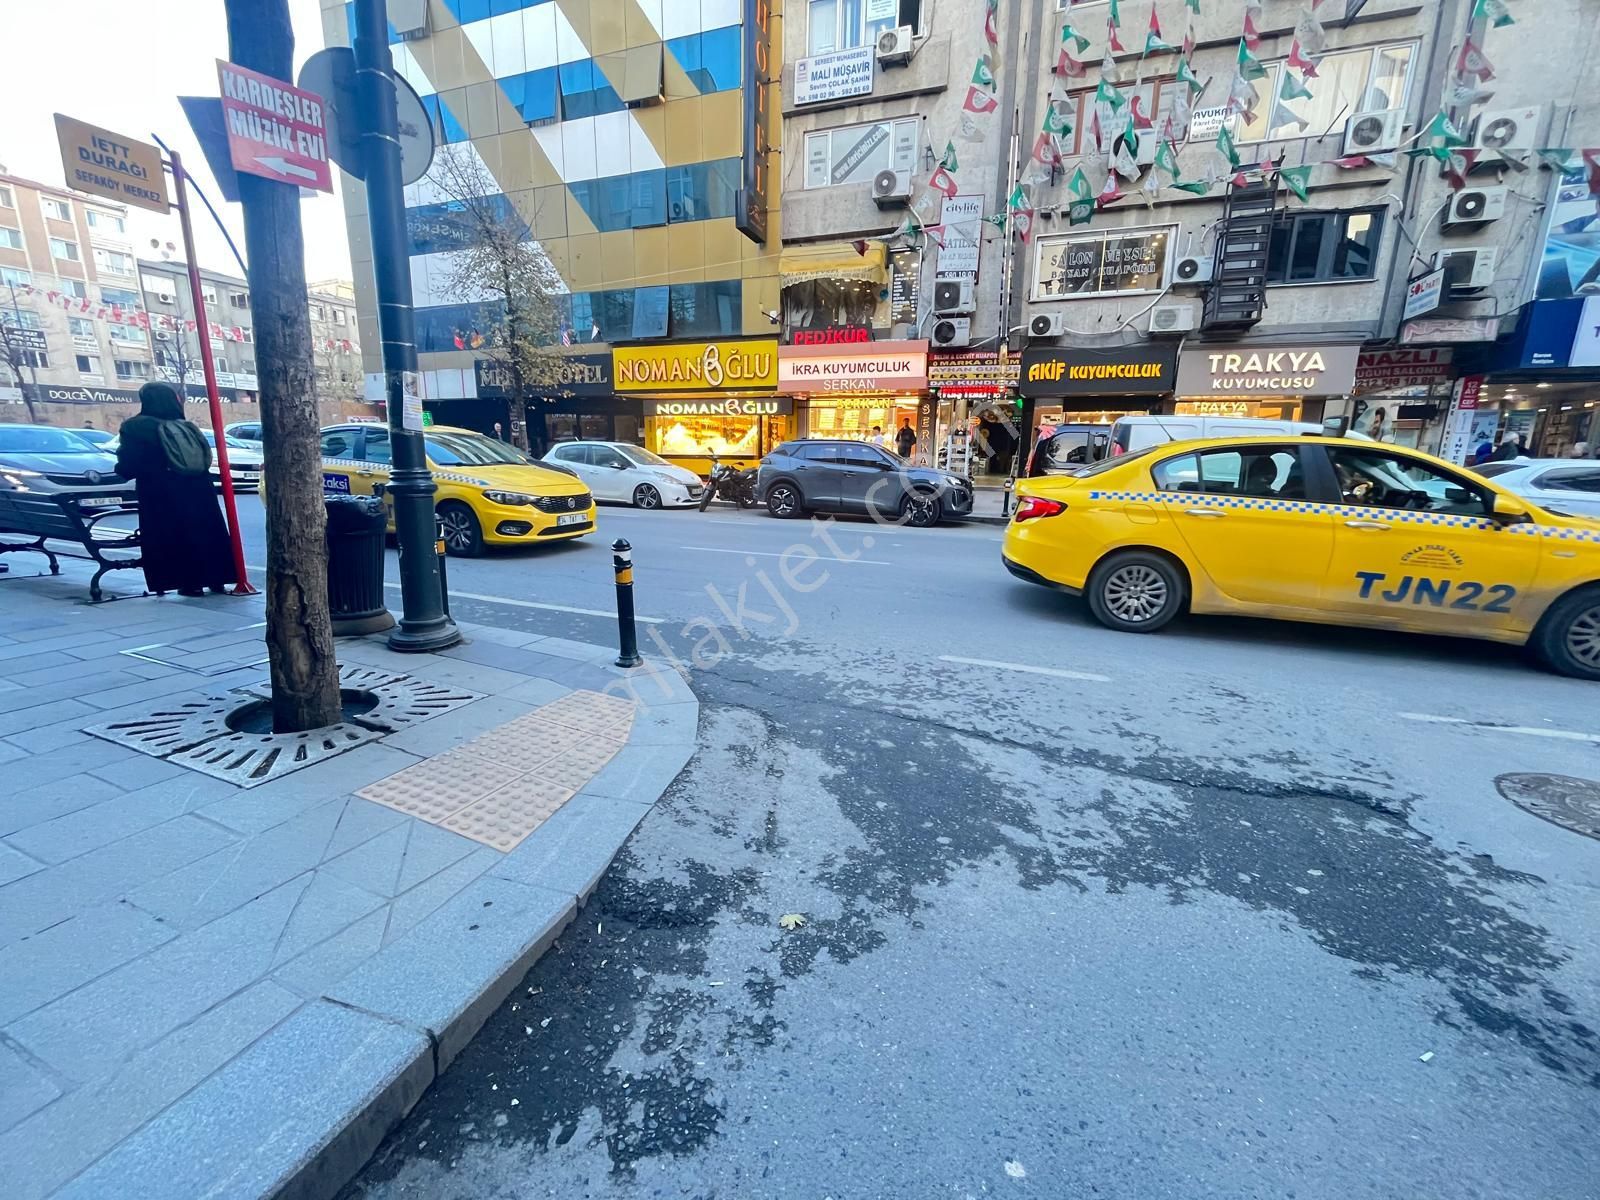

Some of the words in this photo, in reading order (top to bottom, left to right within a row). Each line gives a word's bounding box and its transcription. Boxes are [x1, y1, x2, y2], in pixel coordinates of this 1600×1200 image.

[810, 66, 831, 82] MALİ
[833, 60, 870, 78] MÜŞAVİR
[828, 78, 850, 89] ÇOLAK
[851, 74, 870, 86] ŞAHİN
[222, 69, 323, 129] KARDEŞLER
[1193, 107, 1233, 120] AVUKAT
[227, 108, 295, 153] MÜZİK
[296, 130, 326, 163] EVİ
[78, 146, 148, 179] DURAĞI
[75, 169, 120, 191] SEFAKÖY
[123, 183, 162, 203] MERKEZ
[946, 202, 979, 213] citylife
[1051, 251, 1094, 267] SALON
[1104, 246, 1157, 263] VEYSEL
[1051, 268, 1090, 279] BAYAN
[793, 324, 869, 345] PEDİKÜR
[792, 363, 821, 375] İKRA
[823, 360, 911, 374] KUYUMCULUK
[1208, 350, 1326, 374] TRAKYA
[1357, 349, 1439, 367] NAZLI
[1028, 358, 1065, 382] AKİF
[1069, 362, 1163, 380] KUYUMCULUK
[1393, 366, 1442, 375] SALONU
[823, 379, 875, 391] SERKAN
[1212, 376, 1315, 390] KUYUMCUSU
[49, 390, 87, 401] DOLCE
[1192, 402, 1248, 413] TRAKYA
[920, 403, 931, 466] SERKA
[1354, 571, 1516, 614] TJN22
